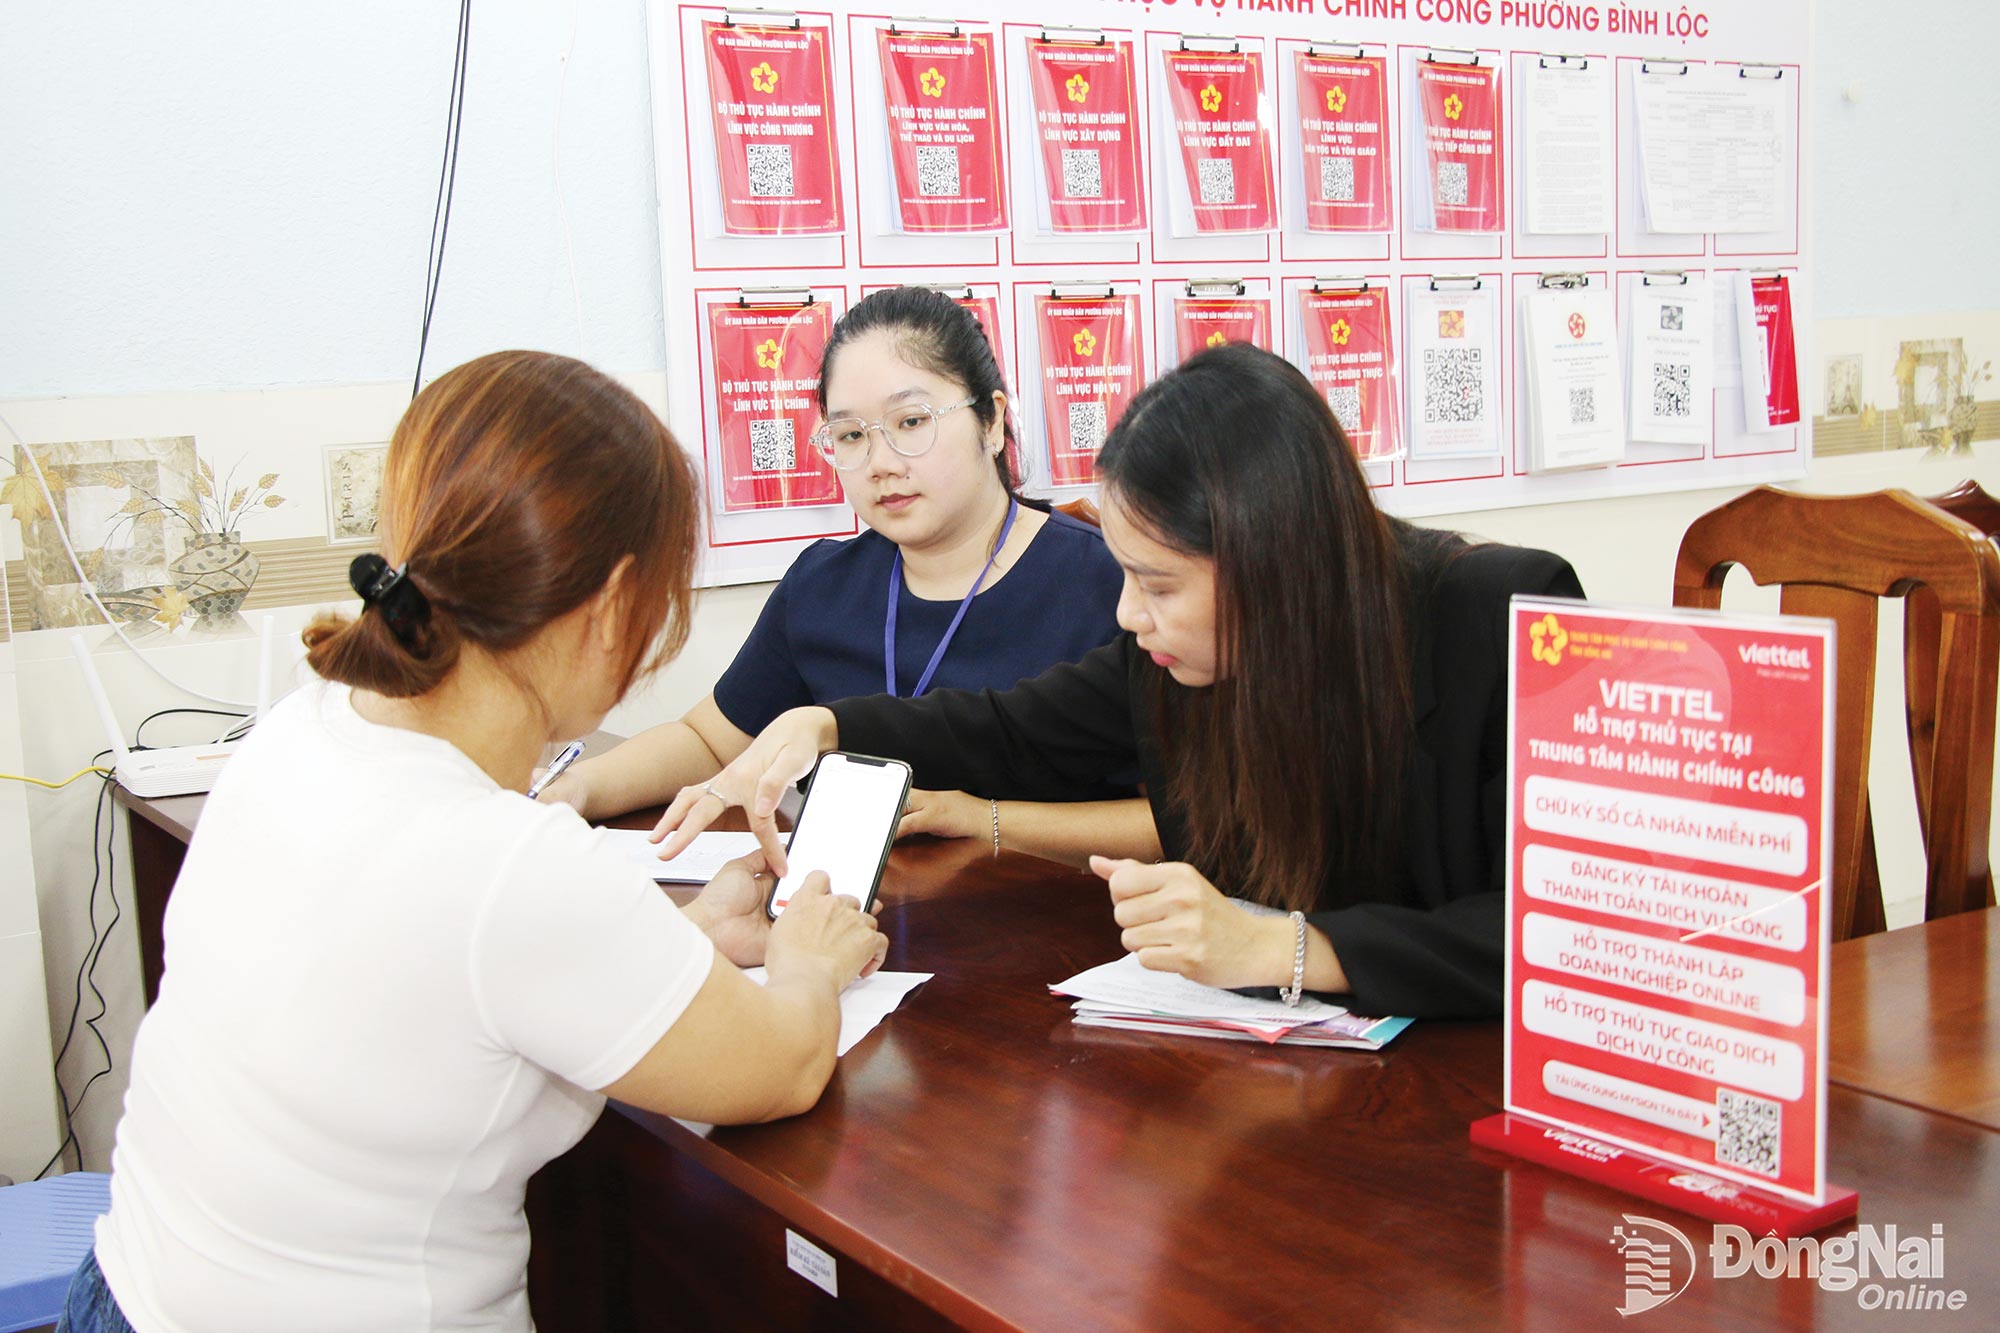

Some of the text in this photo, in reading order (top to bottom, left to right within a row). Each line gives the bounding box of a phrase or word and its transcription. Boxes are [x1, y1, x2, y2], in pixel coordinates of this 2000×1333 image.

[1501, 0, 1600, 31] PHƯỜNG
[1608, 2, 1657, 36] BÌNH
[1664, 5, 1710, 45] LỘC
[718, 101, 821, 119] BỘ THỦ TỤC HÀNH CHÍNH
[890, 105, 986, 122] BỘ THỦ TỤC HÀNH CHÍNH
[722, 381, 733, 395] BỘ
[734, 378, 750, 393] THỦ
[751, 381, 768, 394] TỤC
[770, 379, 793, 392] HÀNH
[1738, 642, 1811, 670] viettel
[1598, 678, 1722, 722] VIETTEL
[1573, 706, 1751, 762] HỖ TRỢ THỦ TỤC TẠI
[1528, 739, 1804, 799] TRUNG TÂM HÀNH CHÍNH CÔNG
[1536, 795, 1791, 854] CHỮ KÝ SỐ CÁ NHÂN MIỄN PHÍ
[1542, 879, 1599, 904] THANH
[1603, 888, 1650, 915] TOÁN
[1655, 901, 1695, 926] DỊCH
[1571, 859, 1747, 908] ĐĂNG KÝ TÀI KHOẢN
[1573, 928, 1744, 983] HỖ TRỢ THÀNH LẬP
[1558, 951, 1761, 1013] DOANH NGHIỆP ONLINE
[1543, 990, 1775, 1068] HỖ TRỢ THỦ TỤC GIAO DỊCH
[1595, 1031, 1714, 1076] DỊCH VỤ CÔNG
